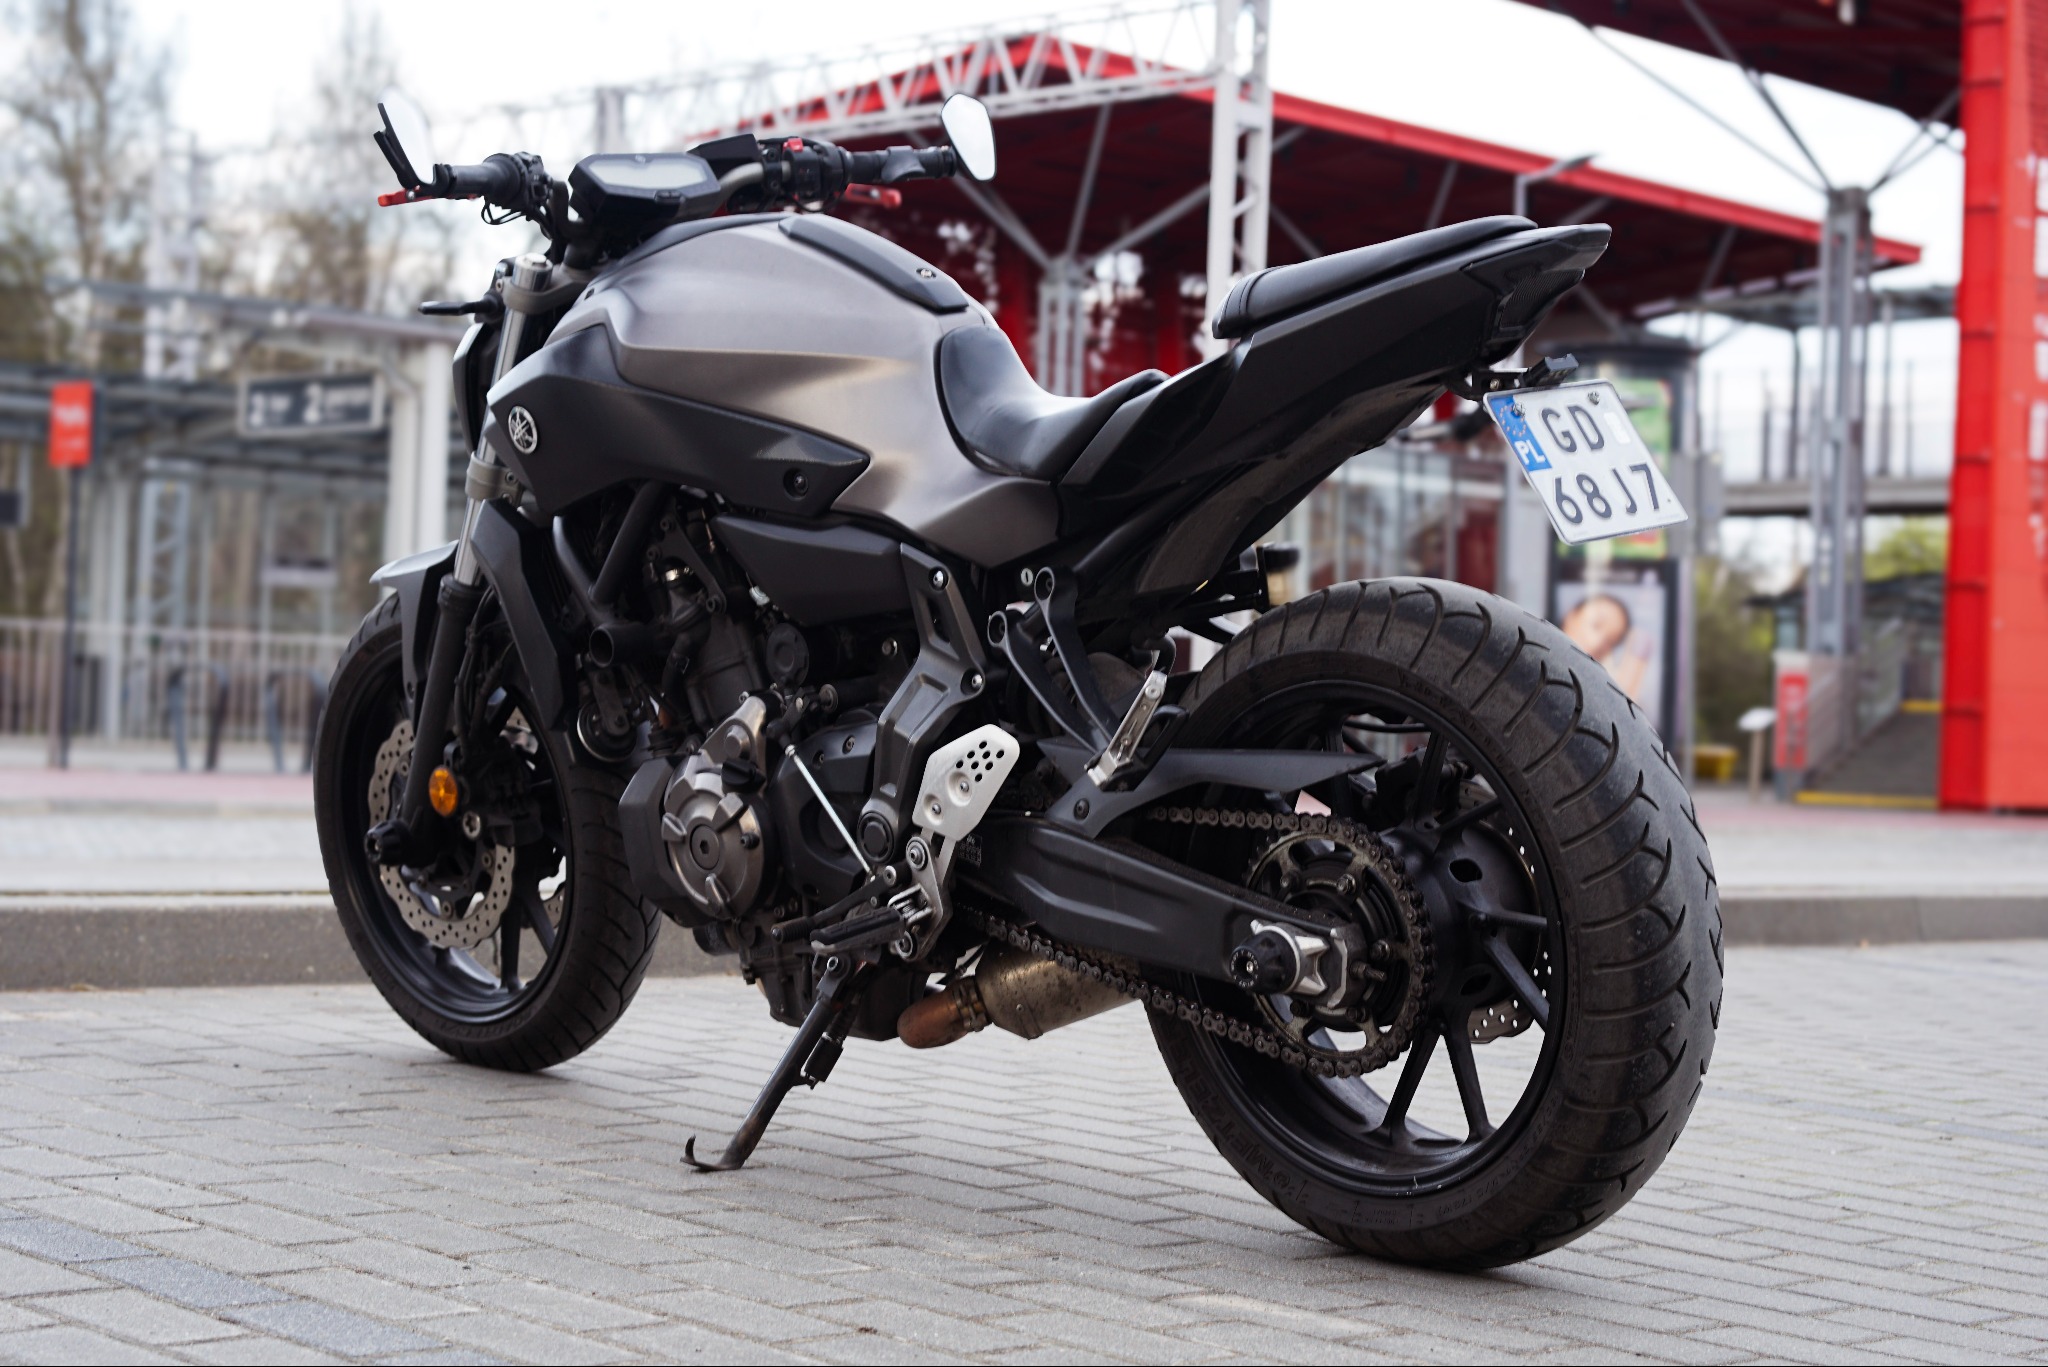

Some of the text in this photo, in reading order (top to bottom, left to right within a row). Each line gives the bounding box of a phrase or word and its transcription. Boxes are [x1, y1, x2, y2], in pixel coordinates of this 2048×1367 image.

[1514, 440, 1546, 466] PL
[1541, 405, 1605, 453] GD
[1555, 463, 1660, 524] 68J7
[1159, 1016, 1272, 1181] METZELER
